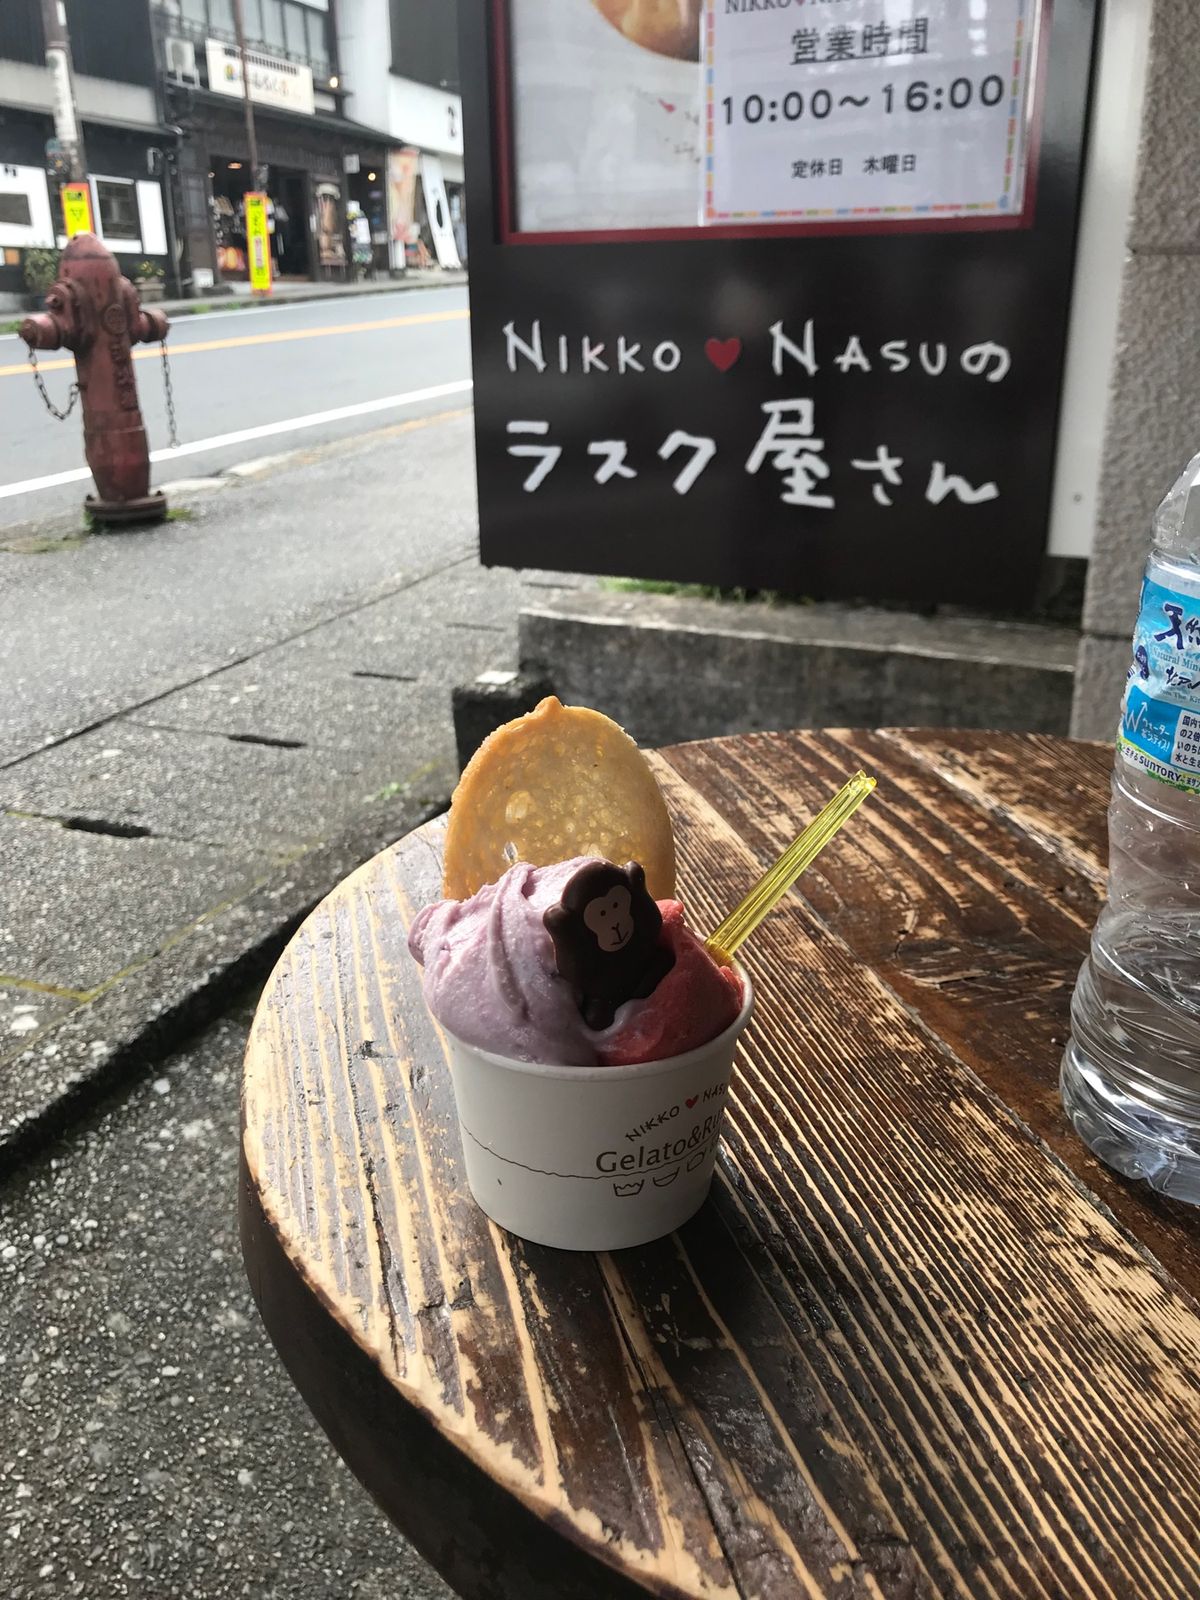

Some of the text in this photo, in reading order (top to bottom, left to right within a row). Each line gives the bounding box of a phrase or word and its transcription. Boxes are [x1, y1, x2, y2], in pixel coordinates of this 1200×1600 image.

[791, 18, 929, 63] 営業時間
[791, 154, 918, 180] 定休日 木曜日
[505, 397, 1000, 510] ラスク屋さん
[1183, 656, 1200, 672] Min
[1139, 755, 1182, 782] SUNTORY
[625, 1083, 725, 1142] NIKKO NAS
